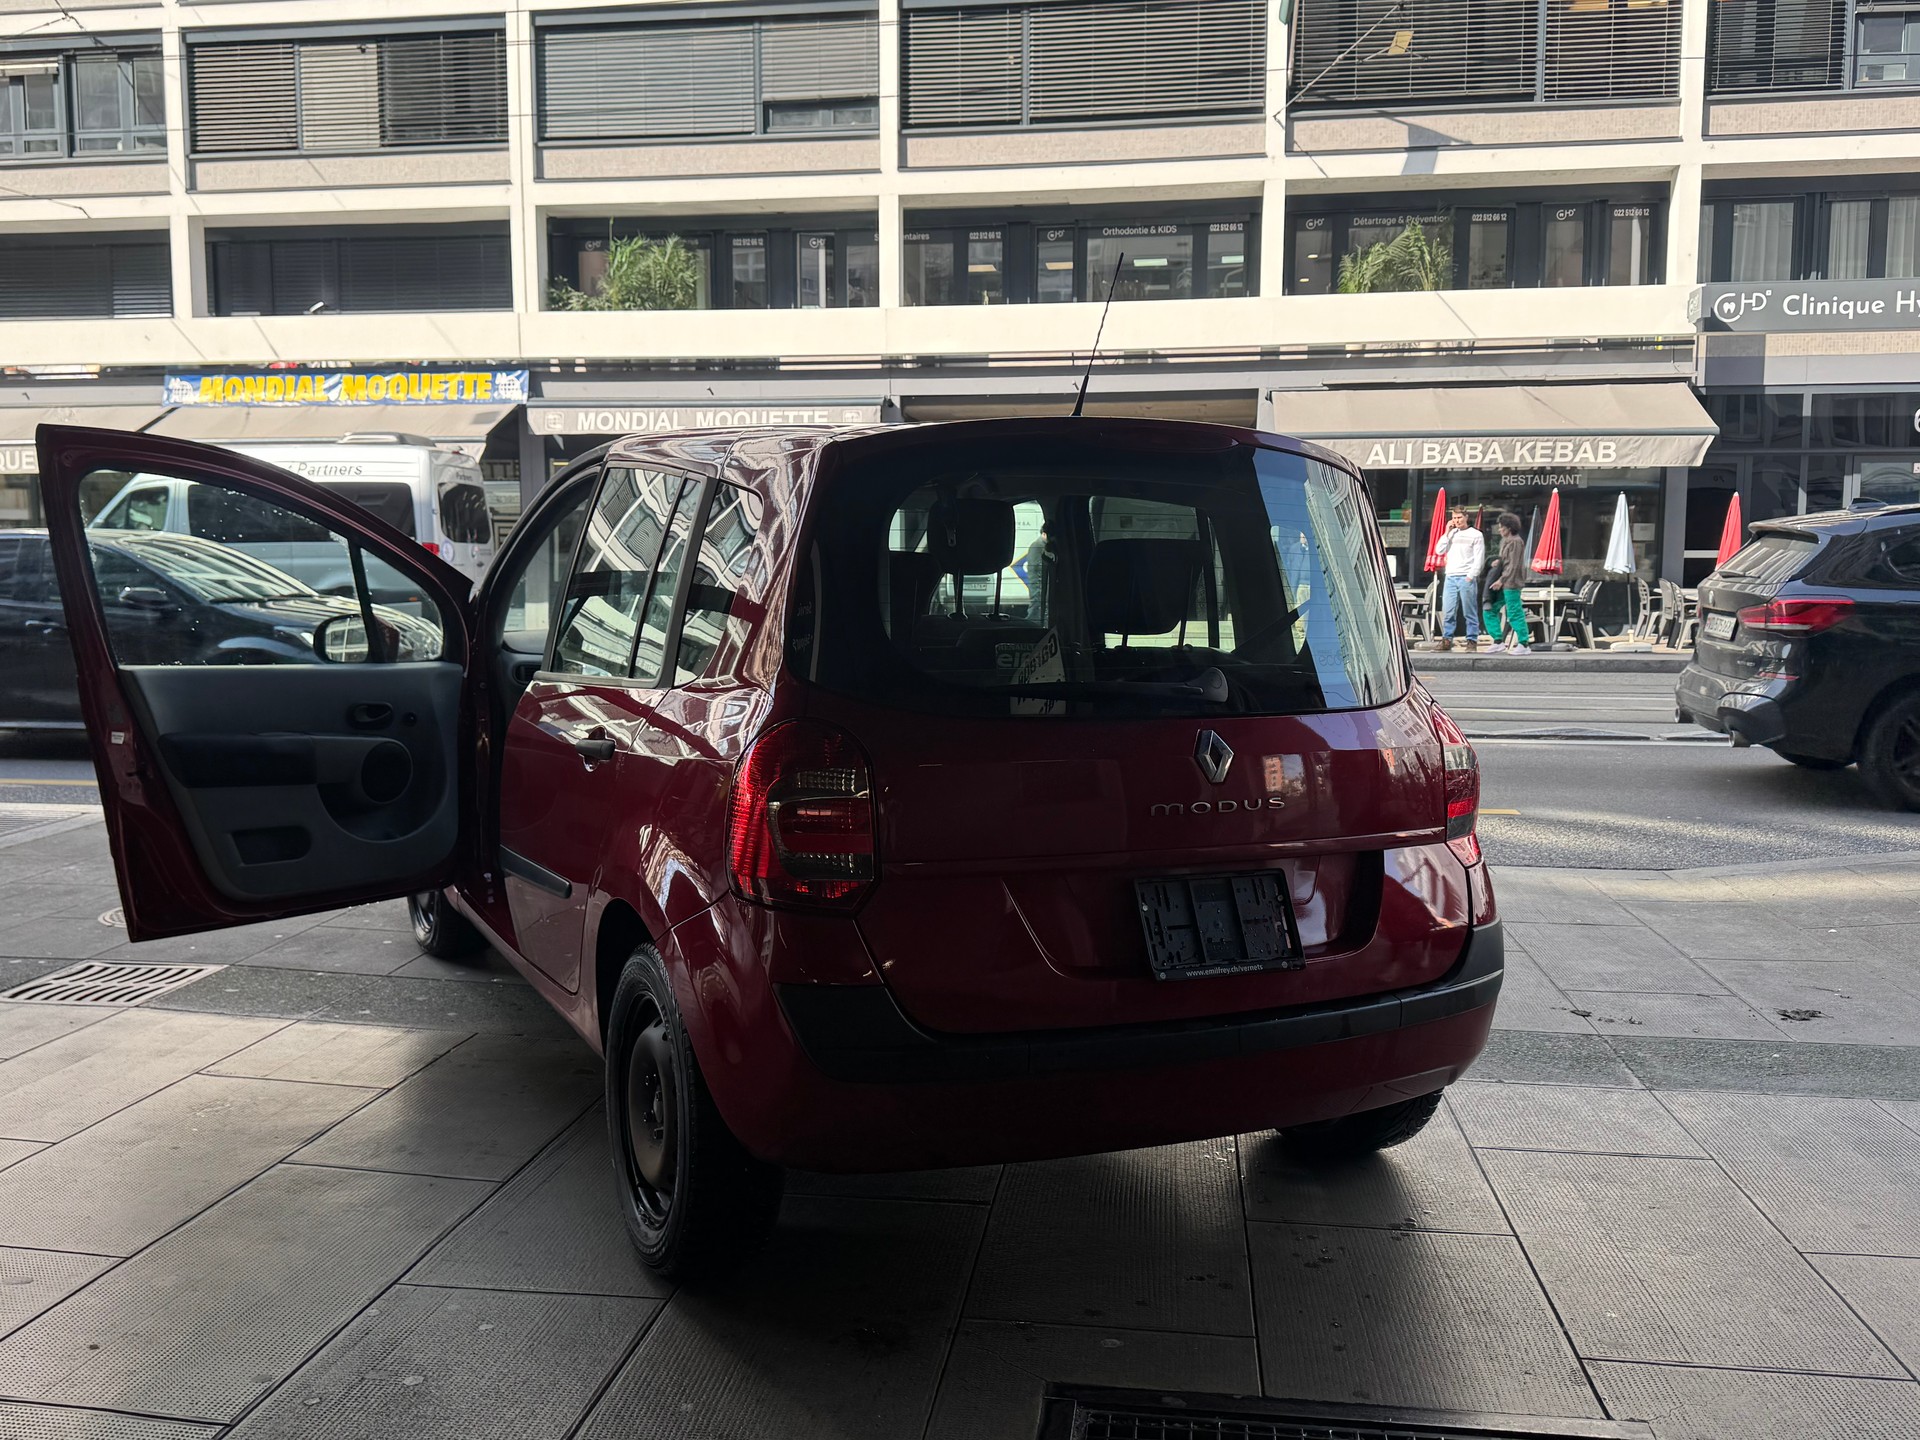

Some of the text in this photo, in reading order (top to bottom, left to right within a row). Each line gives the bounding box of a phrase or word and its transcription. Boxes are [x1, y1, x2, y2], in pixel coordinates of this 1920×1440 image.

[1102, 225, 1178, 236] Orthodontie & KIDS
[1353, 216, 1396, 226] Détartrage
[1398, 215, 1404, 224] &
[904, 232, 930, 240] ntaires
[1783, 293, 1885, 320] Clinique
[199, 372, 491, 402] MONDIAL MOQUETTE
[577, 411, 687, 431] MONDIAL
[0, 449, 36, 470] UE
[1366, 441, 1618, 465] ALI BABA KEBAB
[298, 462, 363, 476] Partners
[1501, 474, 1582, 486] RESTAURANT
[1150, 796, 1286, 817] MODUS
